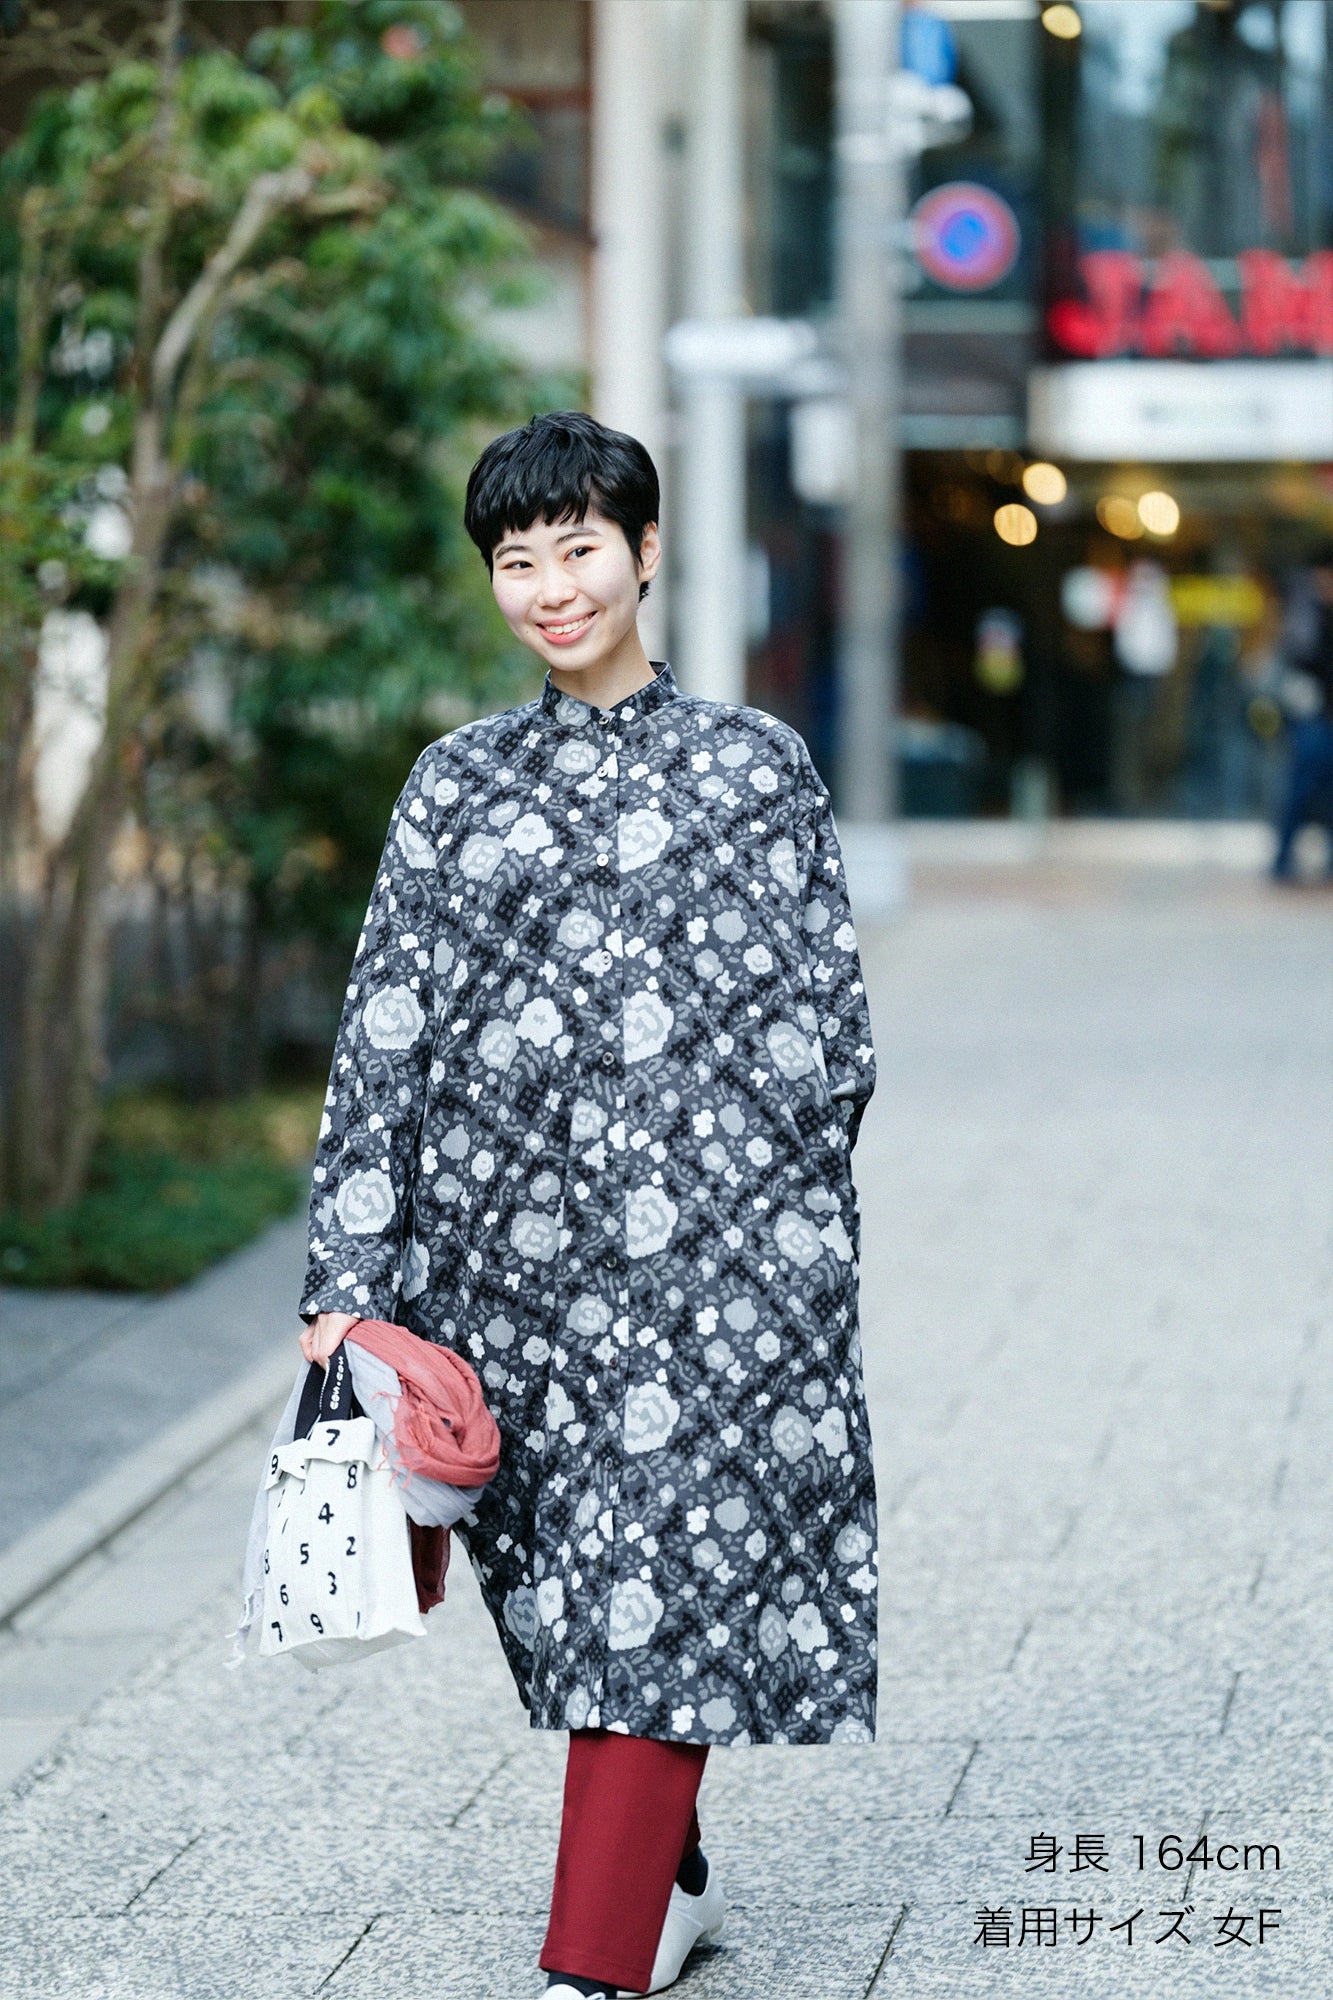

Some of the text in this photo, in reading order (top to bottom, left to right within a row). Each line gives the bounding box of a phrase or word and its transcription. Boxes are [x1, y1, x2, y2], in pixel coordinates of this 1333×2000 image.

[326, 1428, 341, 1447] 7
[271, 1454, 279, 1475] 9
[347, 1464, 358, 1489] 8
[318, 1503, 335, 1525] 4
[300, 1543, 310, 1565] 5
[346, 1536, 357, 1556] 2
[327, 1571, 338, 1595] 3
[279, 1583, 289, 1606] 6
[271, 1621, 283, 1642] 7
[310, 1613, 324, 1635] 9
